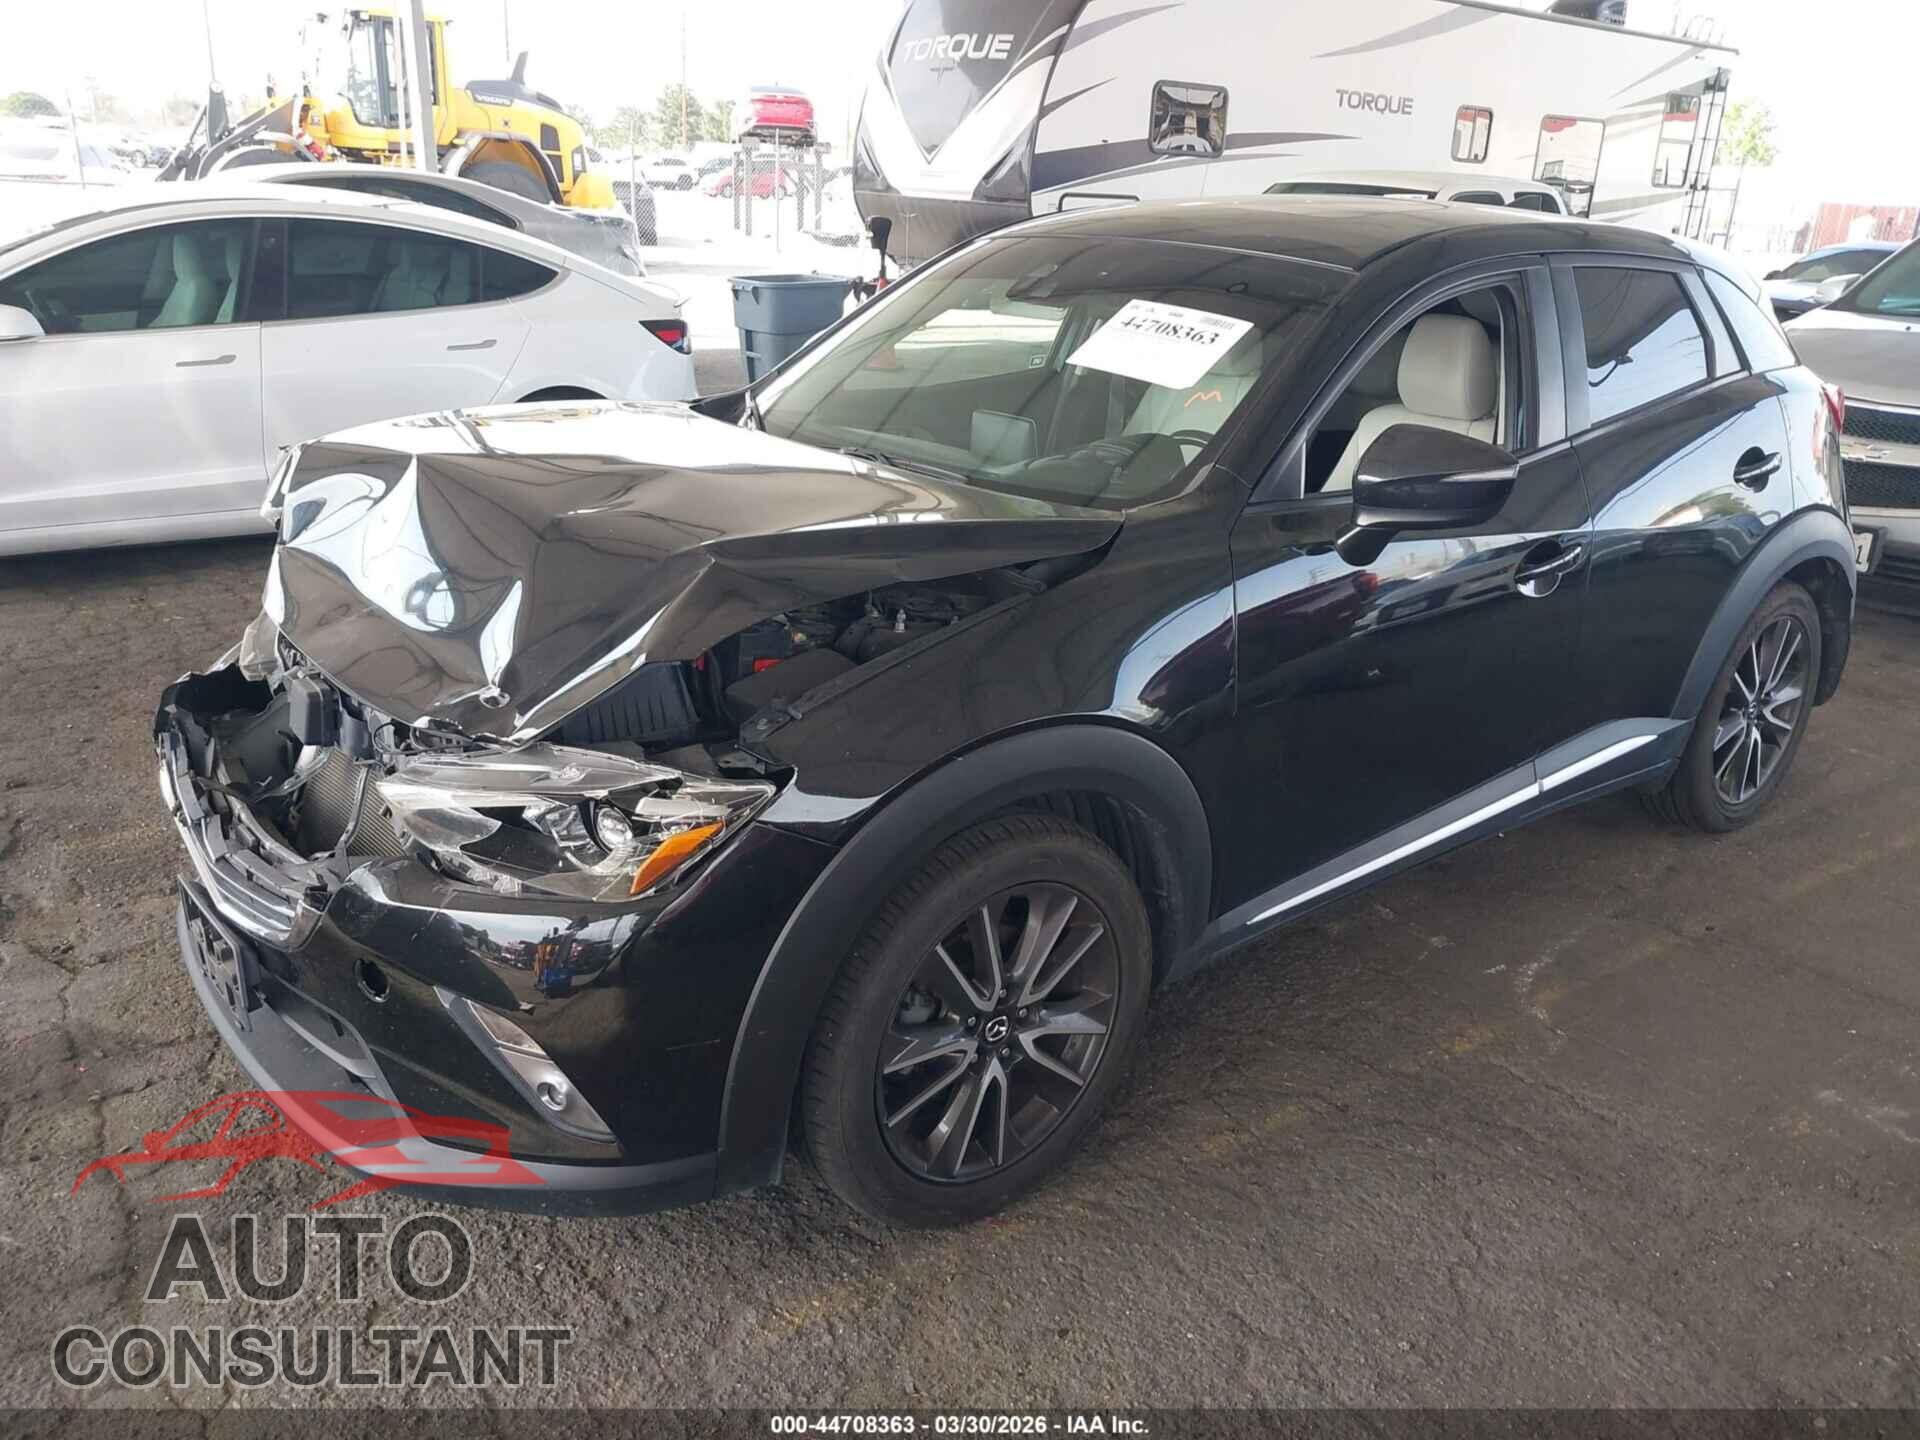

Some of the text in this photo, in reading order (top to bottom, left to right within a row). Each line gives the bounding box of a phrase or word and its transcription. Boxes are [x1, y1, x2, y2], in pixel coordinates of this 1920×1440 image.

[903, 33, 1015, 63] TORQUE
[1335, 88, 1414, 115] TORQUE
[1121, 316, 1220, 345] 44708363
